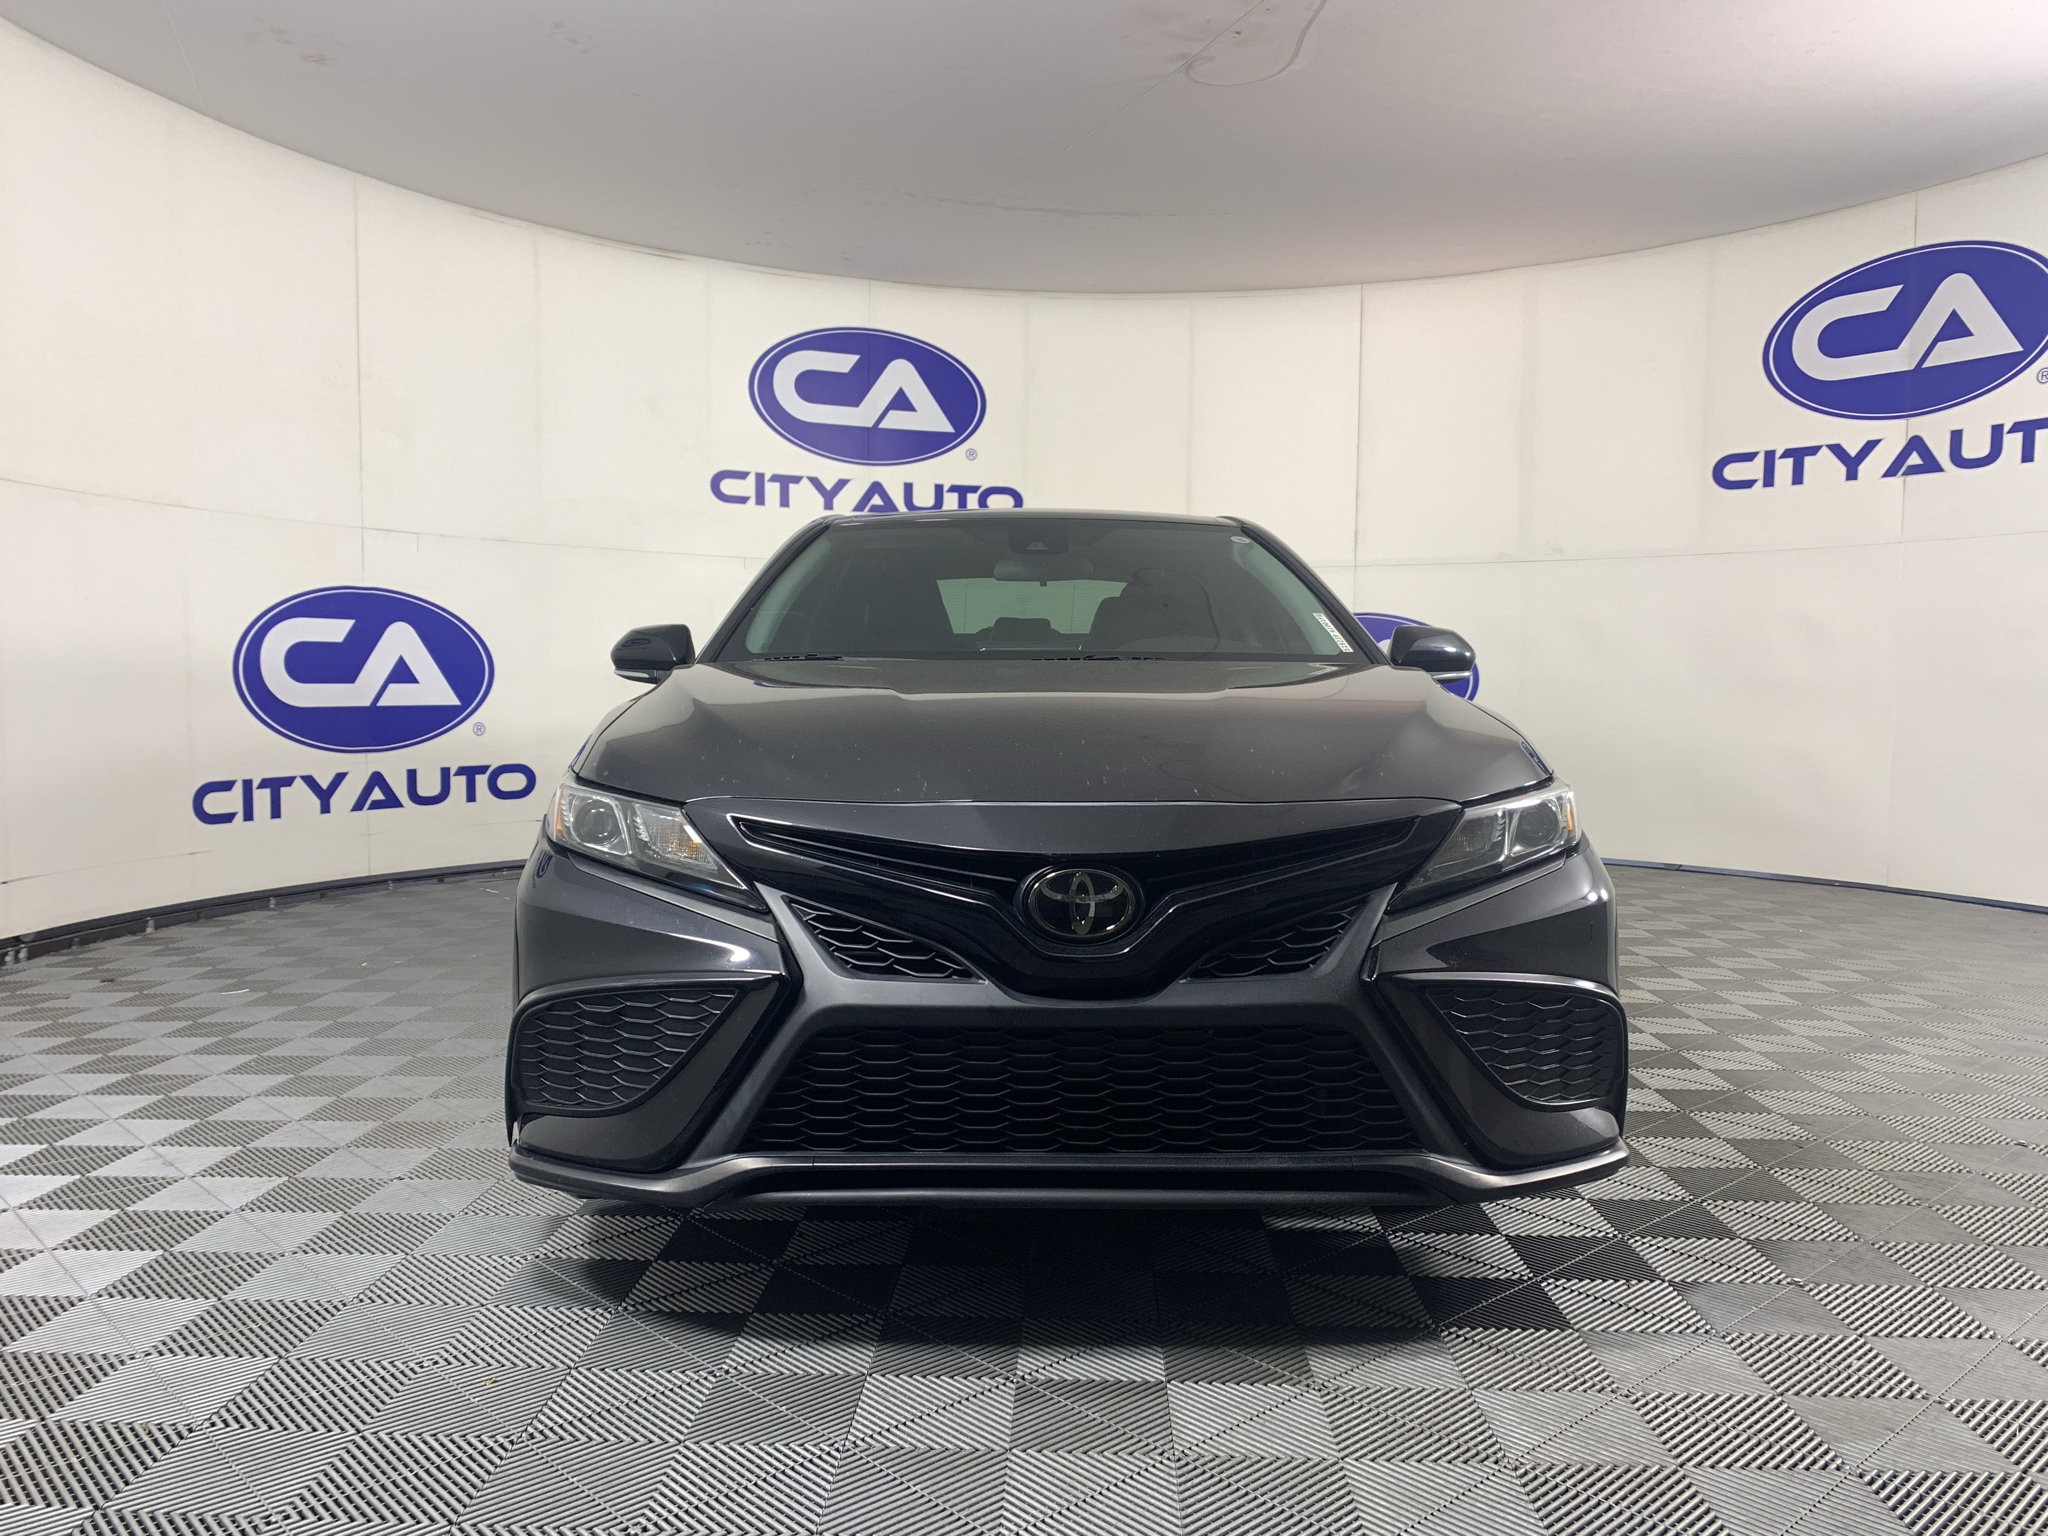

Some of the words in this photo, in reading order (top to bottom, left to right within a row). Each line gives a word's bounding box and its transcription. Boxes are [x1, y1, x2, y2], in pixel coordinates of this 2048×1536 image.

[1791, 272, 2025, 381] CA
[773, 350, 955, 433] CA
[259, 617, 462, 708] CA
